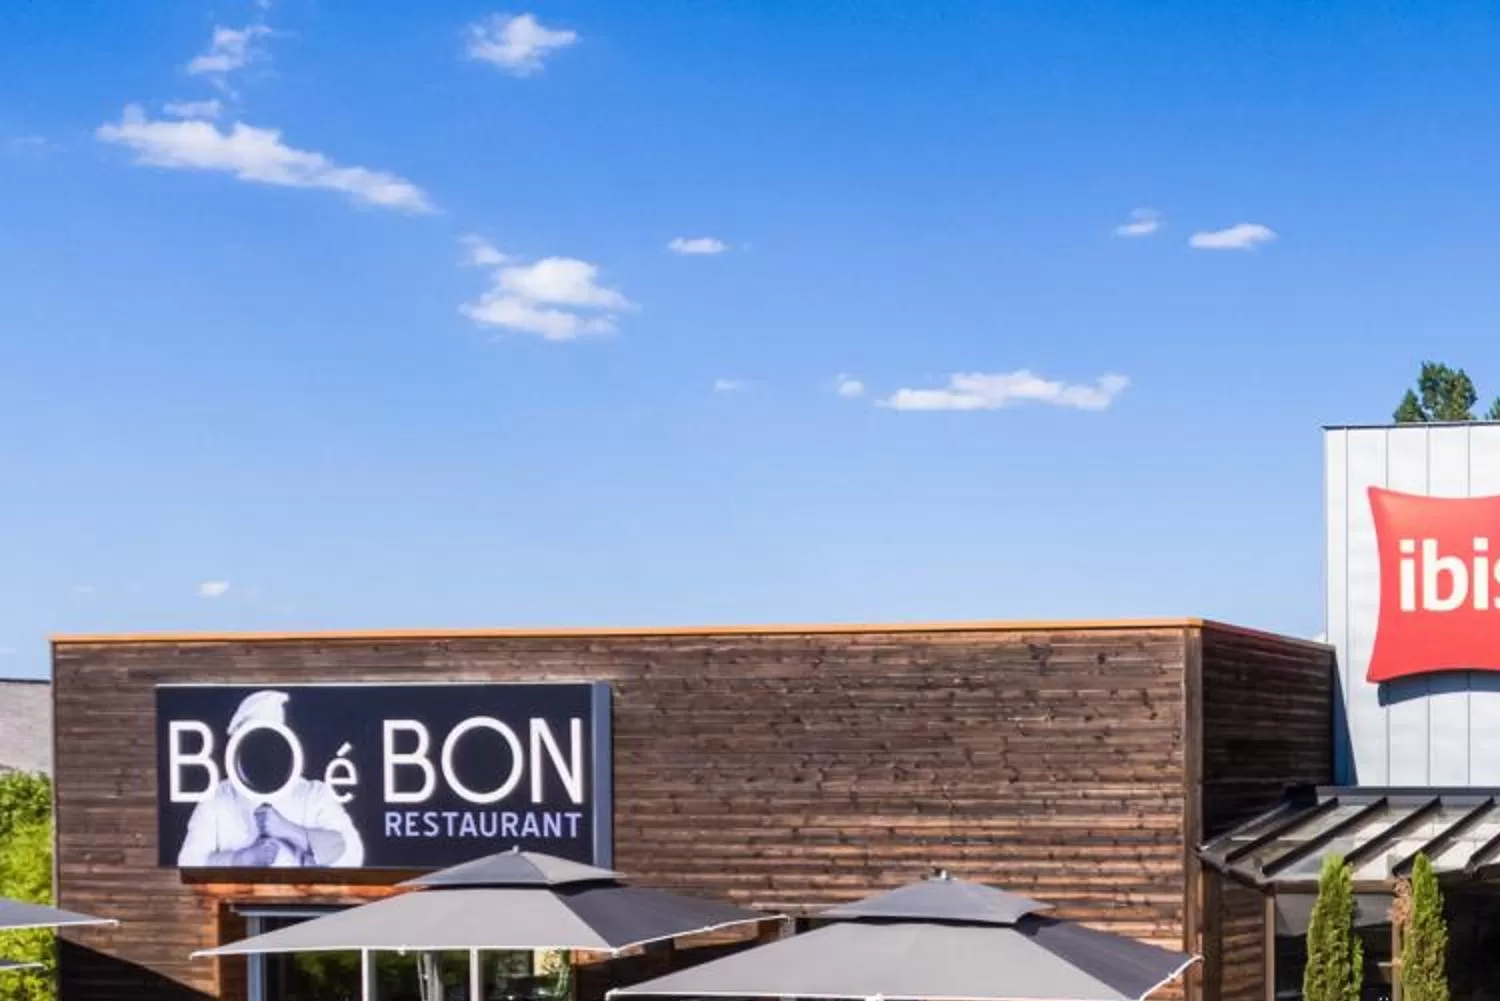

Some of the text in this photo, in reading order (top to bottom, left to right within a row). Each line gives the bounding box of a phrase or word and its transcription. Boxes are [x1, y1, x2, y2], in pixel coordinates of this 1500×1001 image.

[169, 720, 303, 802] BO
[383, 716, 584, 804] BON
[385, 811, 583, 838] RESTAURANT
